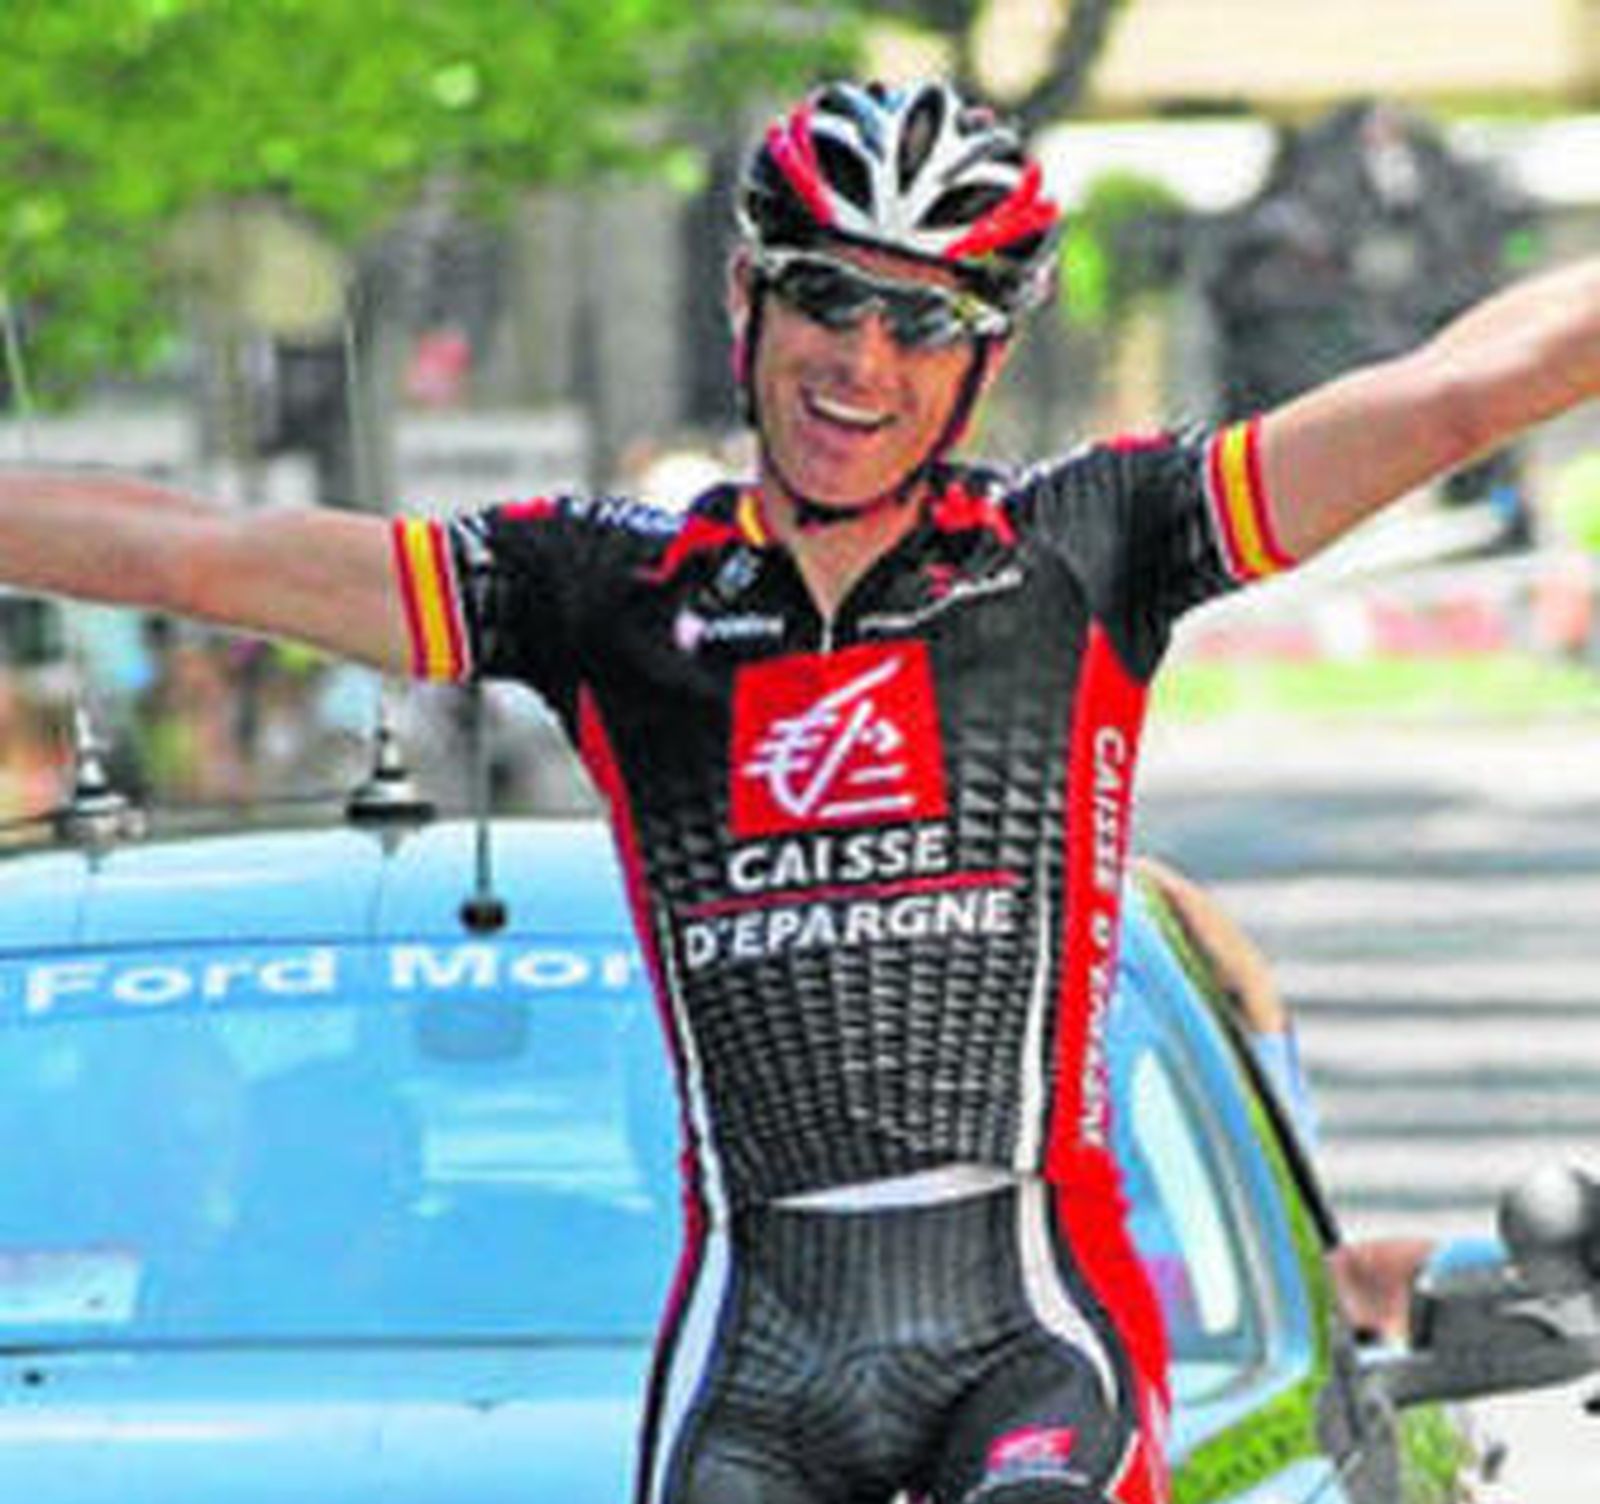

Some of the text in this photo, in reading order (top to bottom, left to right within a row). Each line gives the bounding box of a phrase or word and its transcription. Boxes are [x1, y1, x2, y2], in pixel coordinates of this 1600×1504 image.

[728, 823, 949, 892] CAISSE
[683, 888, 1017, 969] D'EPARGNE
[24, 944, 338, 1012] Ford
